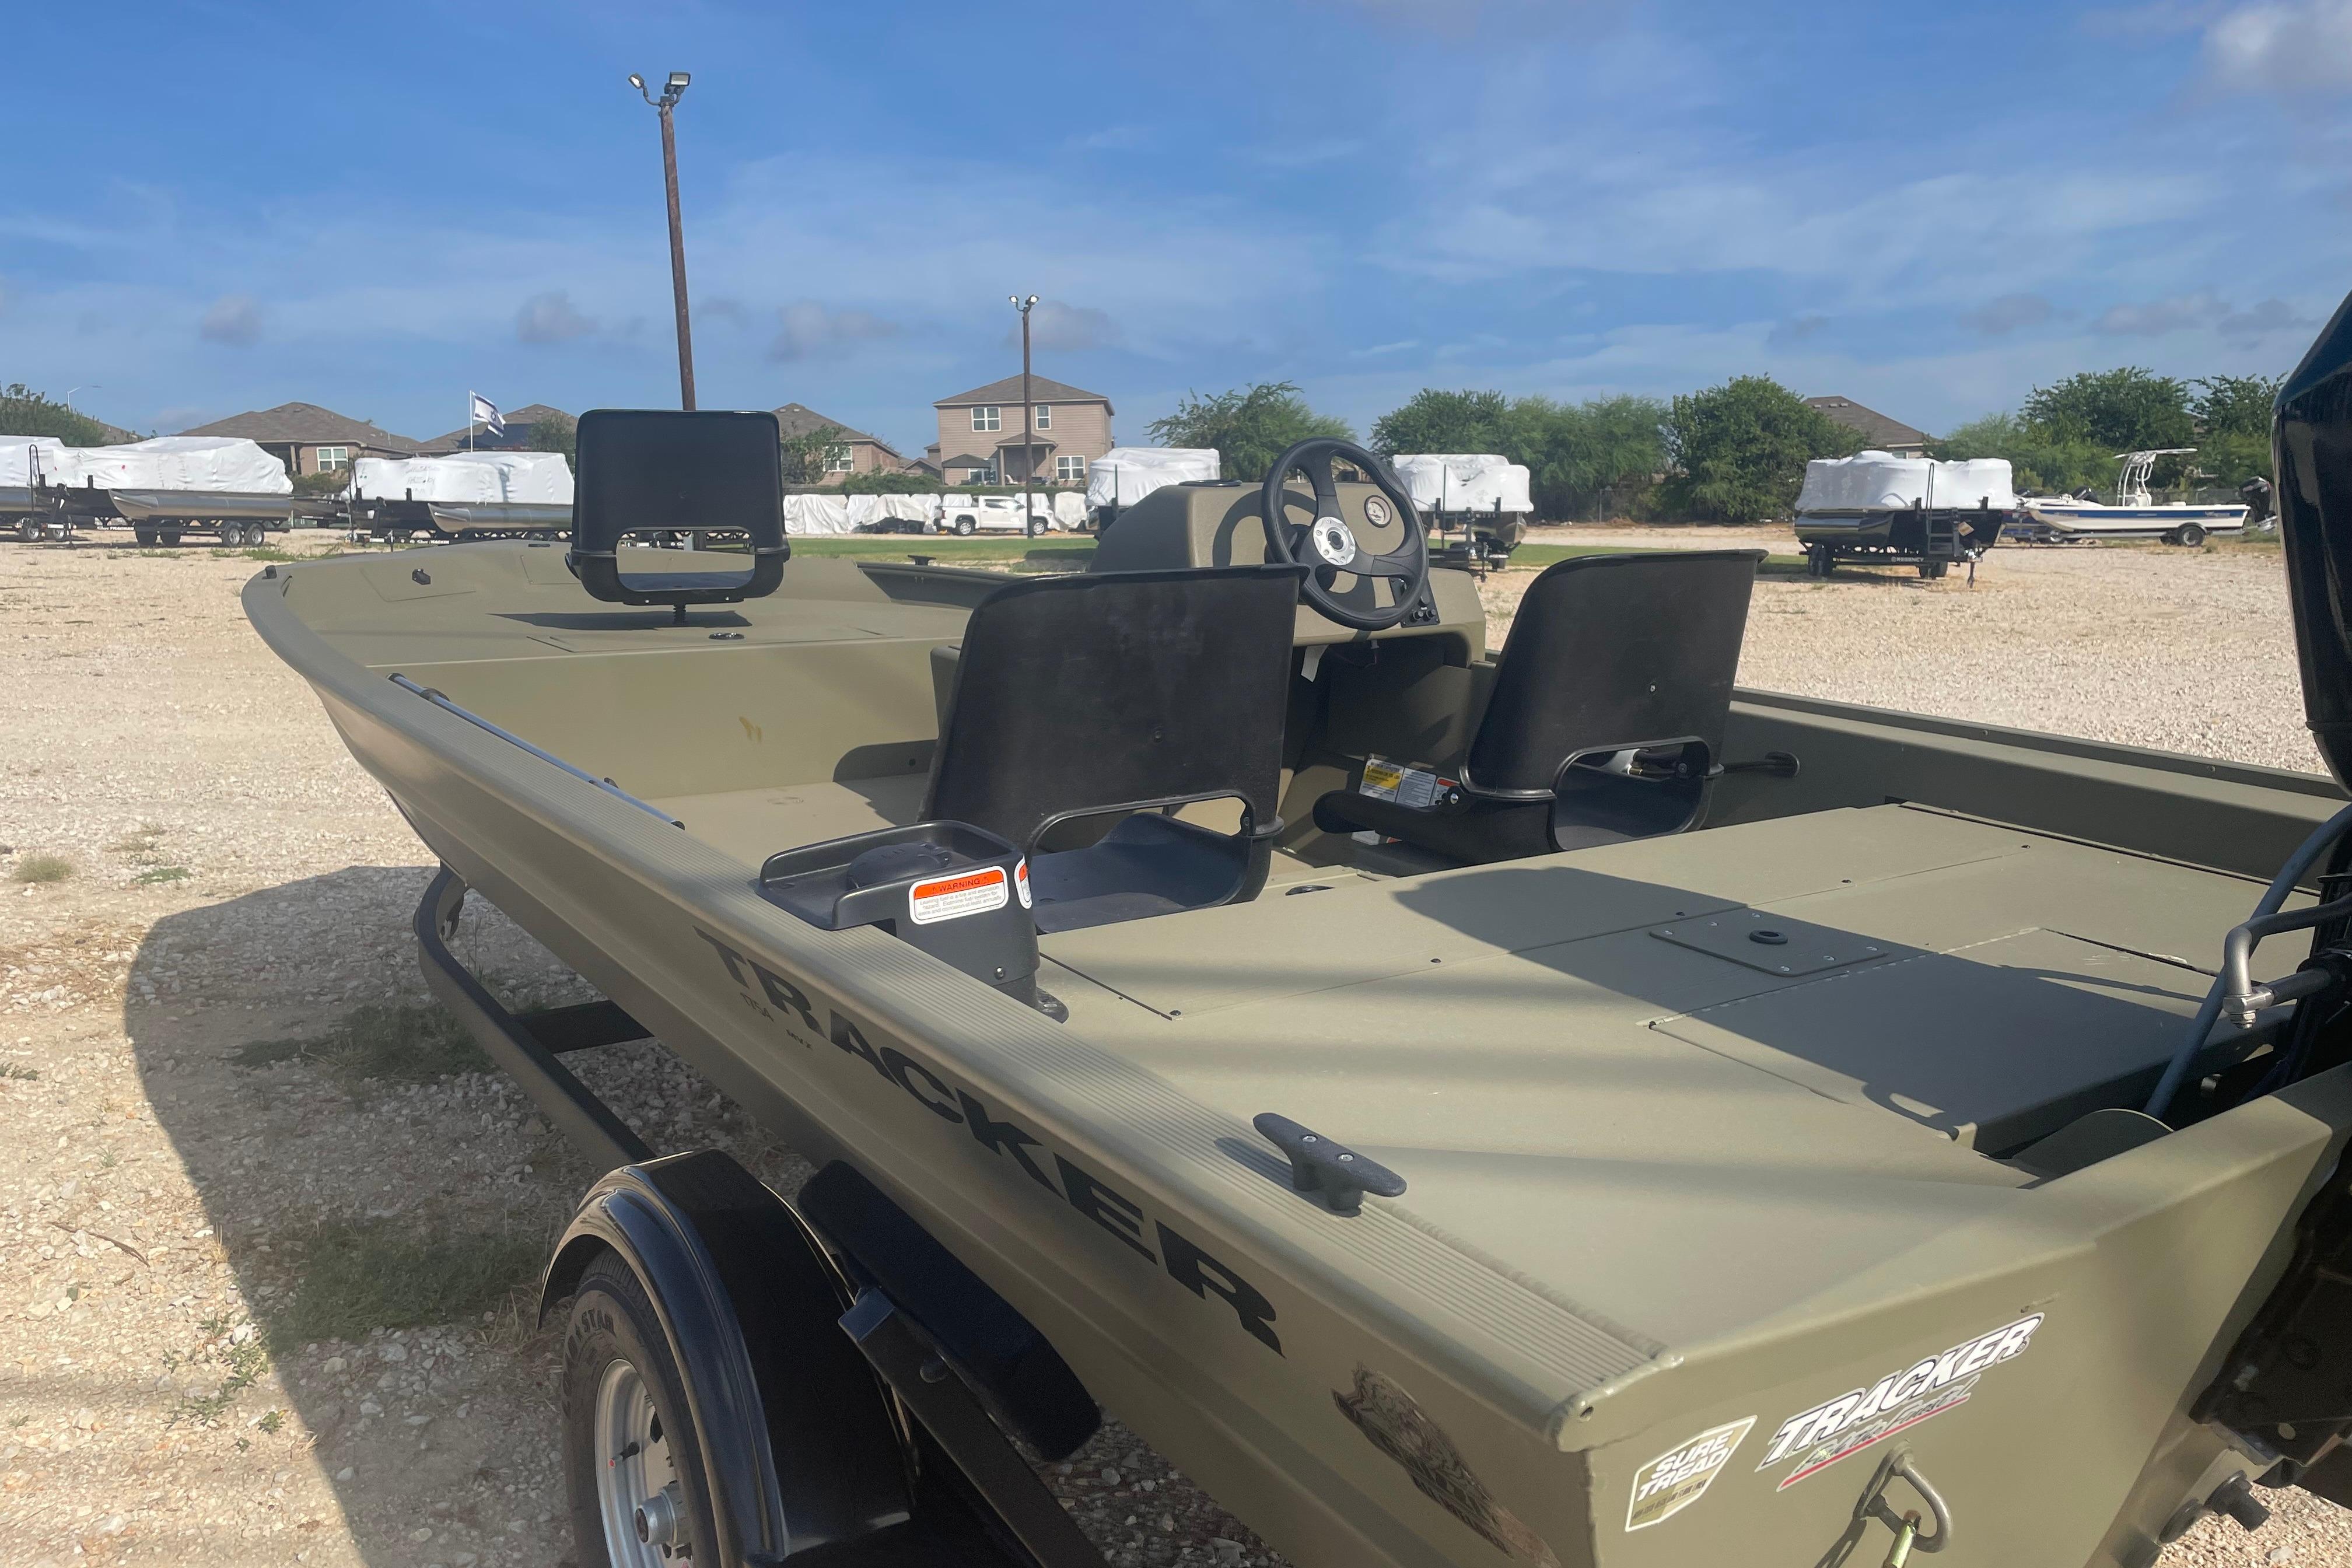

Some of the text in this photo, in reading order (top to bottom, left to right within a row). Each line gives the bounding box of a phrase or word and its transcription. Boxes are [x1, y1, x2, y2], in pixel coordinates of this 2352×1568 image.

[939, 878, 981, 892] WARNING
[695, 926, 1285, 1358] TRACKER
[1761, 1315, 2042, 1466] TRACKER
[1637, 1447, 1730, 1502] TREAD
[1651, 1430, 1734, 1479] SURE
